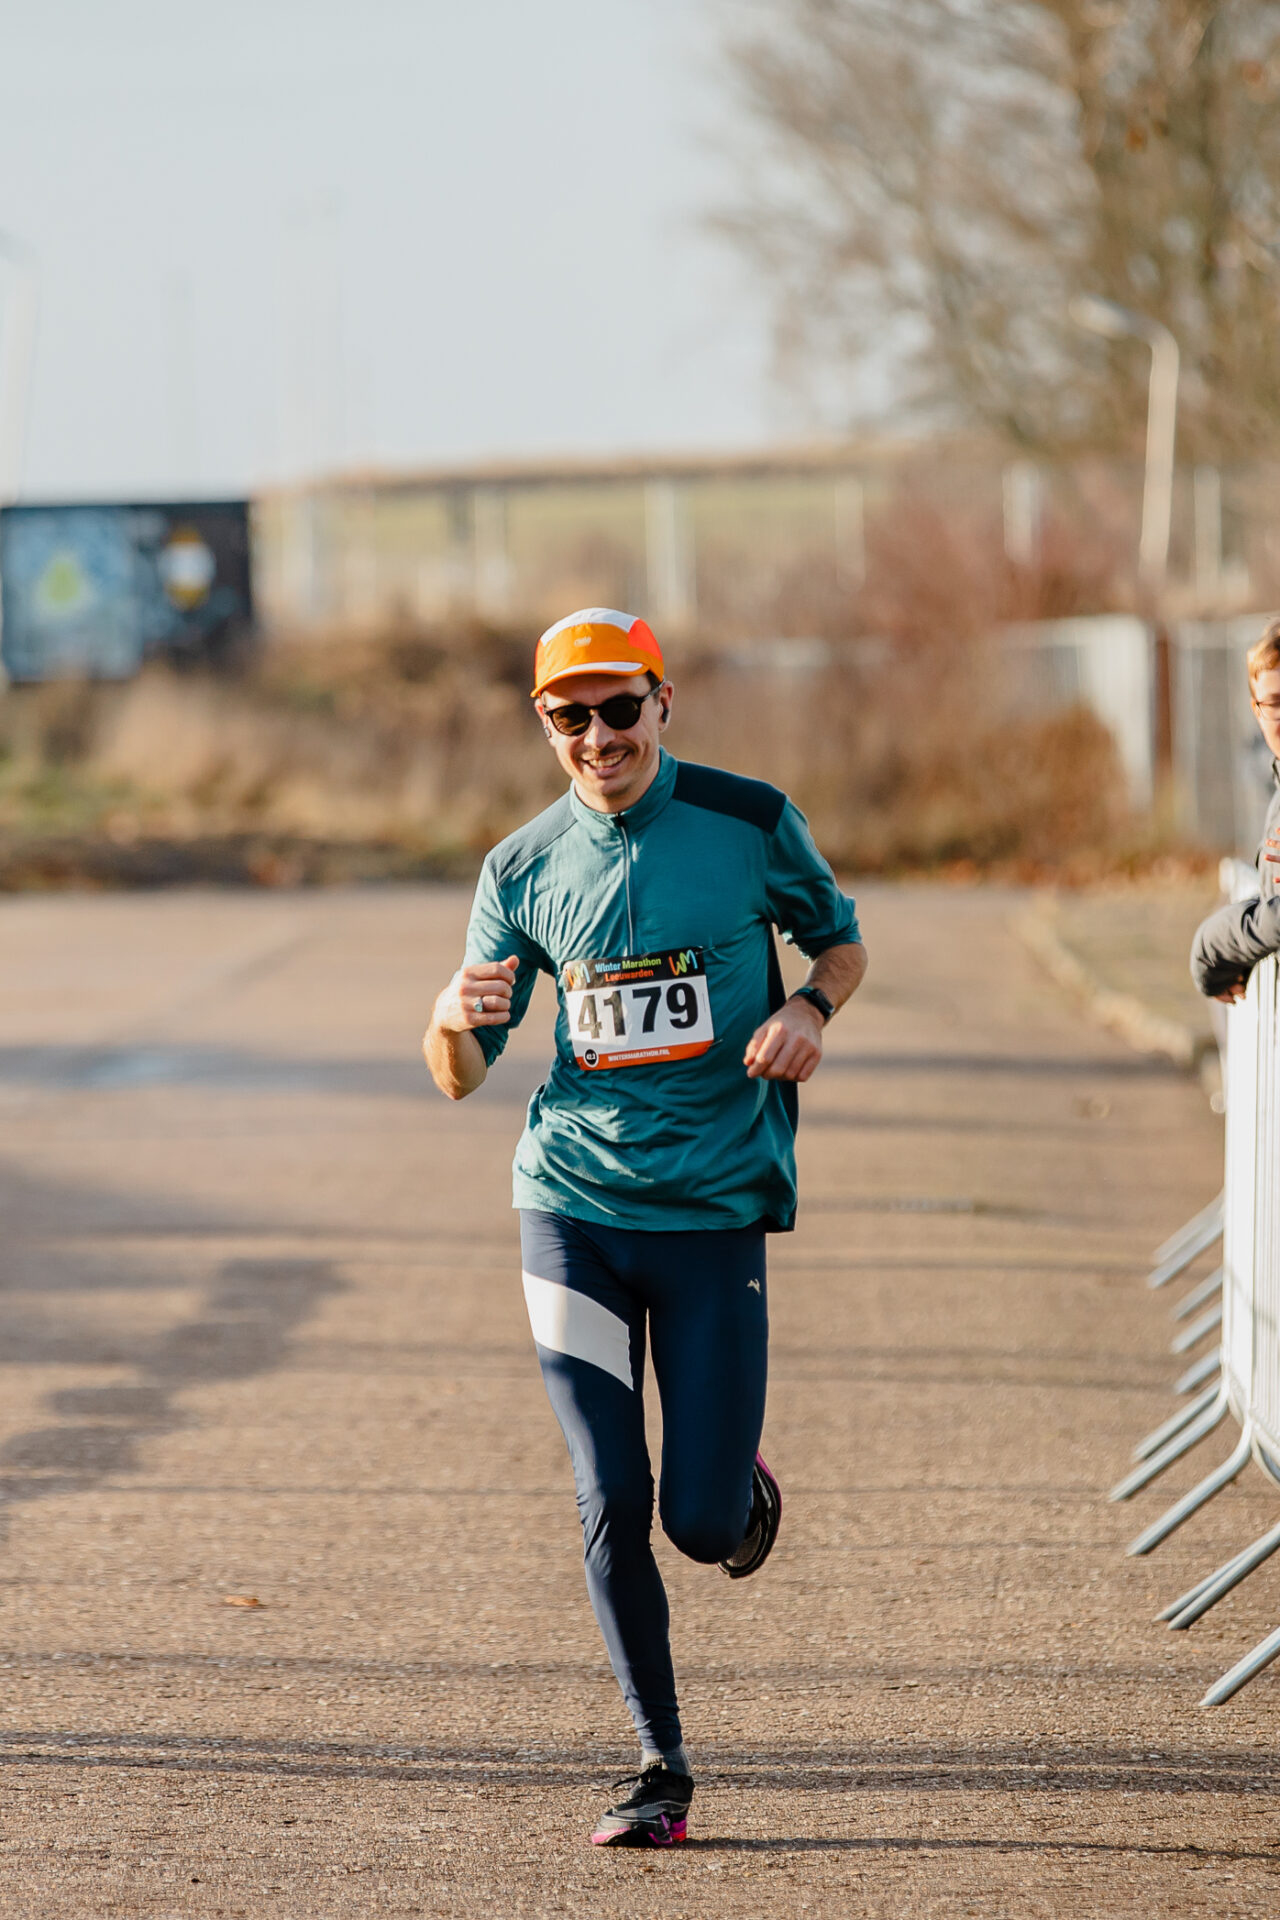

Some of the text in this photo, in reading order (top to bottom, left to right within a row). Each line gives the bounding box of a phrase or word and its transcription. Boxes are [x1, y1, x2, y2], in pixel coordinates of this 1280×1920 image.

[594, 958, 662, 973] Winter Marathon
[605, 969, 654, 982] Leeuwarden
[577, 982, 699, 1040] 4179
